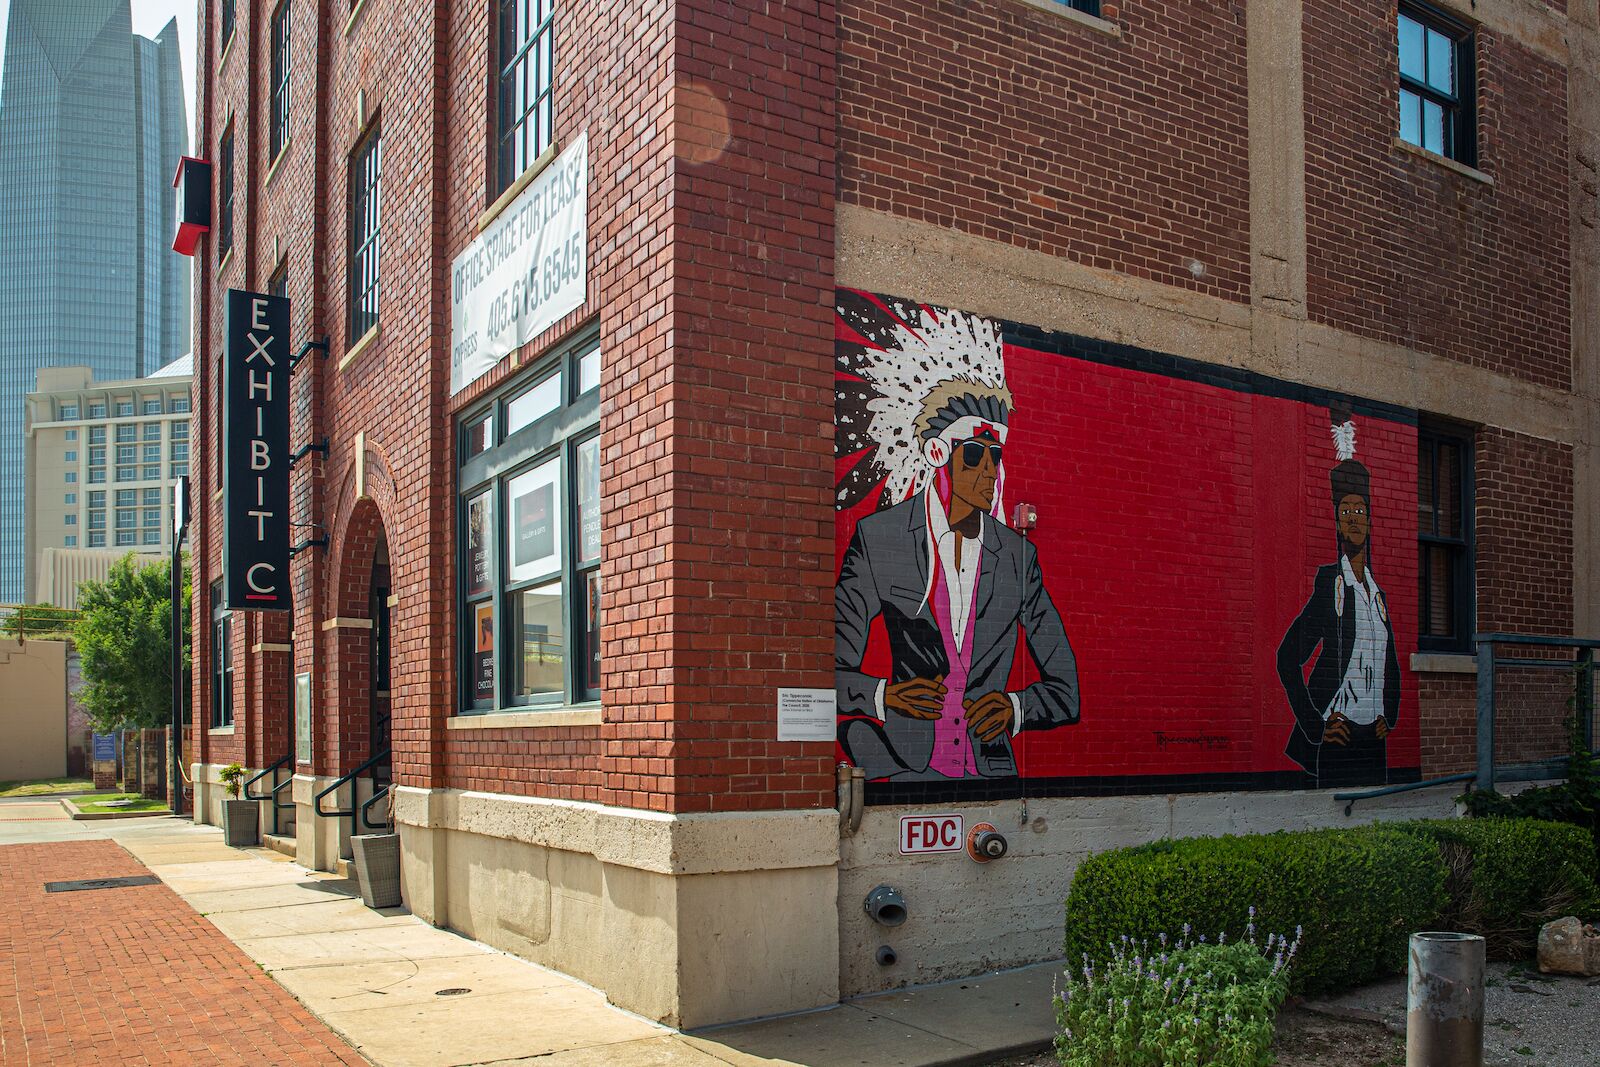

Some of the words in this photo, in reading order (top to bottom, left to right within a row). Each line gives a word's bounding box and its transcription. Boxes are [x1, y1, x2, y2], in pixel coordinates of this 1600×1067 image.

[455, 255, 484, 305] OFFICE
[486, 215, 517, 274] SPACE
[519, 192, 540, 247] FOR
[543, 157, 581, 225] LEASE
[486, 230, 581, 343] 405.615.6545
[245, 298, 276, 542] EXHIBIT
[246, 562, 276, 593] C
[907, 819, 956, 848] FDC
